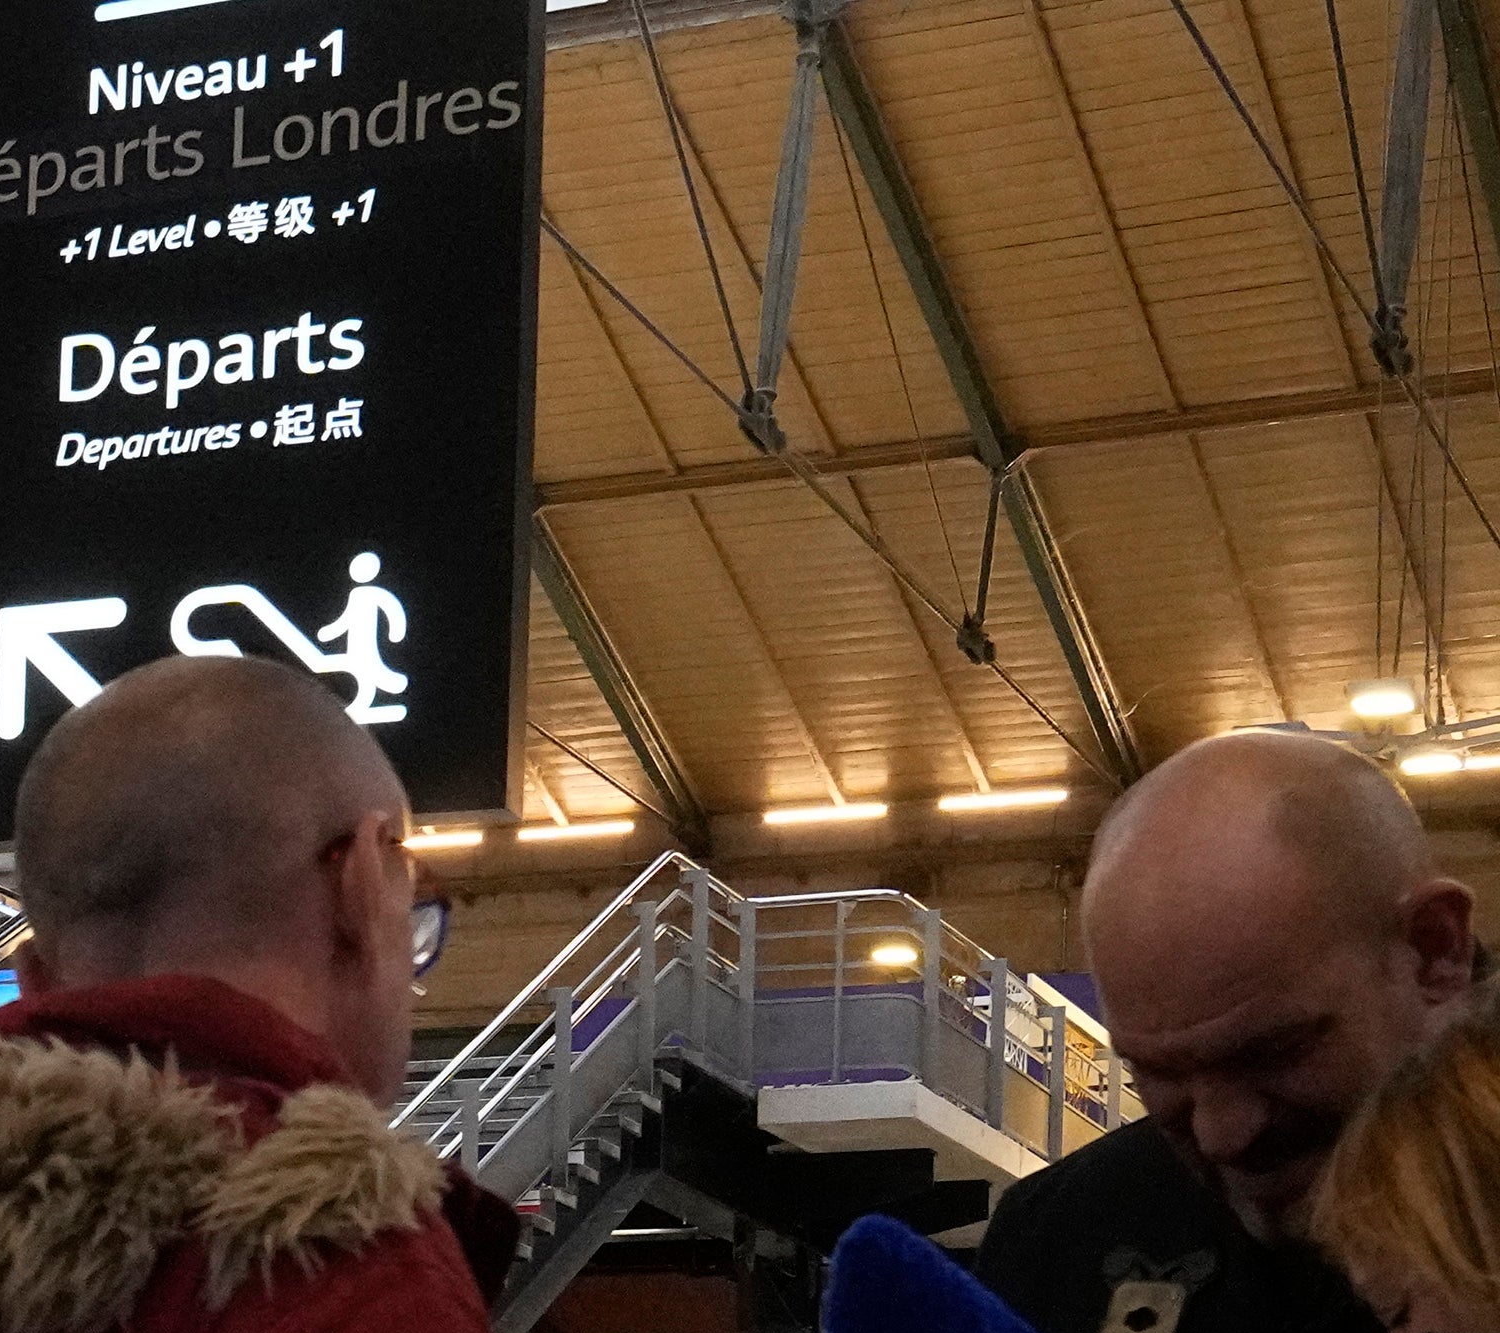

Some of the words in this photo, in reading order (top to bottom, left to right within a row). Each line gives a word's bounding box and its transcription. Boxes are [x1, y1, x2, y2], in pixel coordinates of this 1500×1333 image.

[87, 51, 269, 115] Niveau
[283, 28, 346, 84] +1
[230, 79, 523, 169] Londres
[59, 227, 100, 264] +1
[107, 214, 196, 260] Level
[227, 195, 316, 245] 等级
[331, 188, 378, 226] +1
[58, 311, 366, 410] Départs
[54, 422, 244, 471] Departures
[272, 397, 365, 448] 起点
